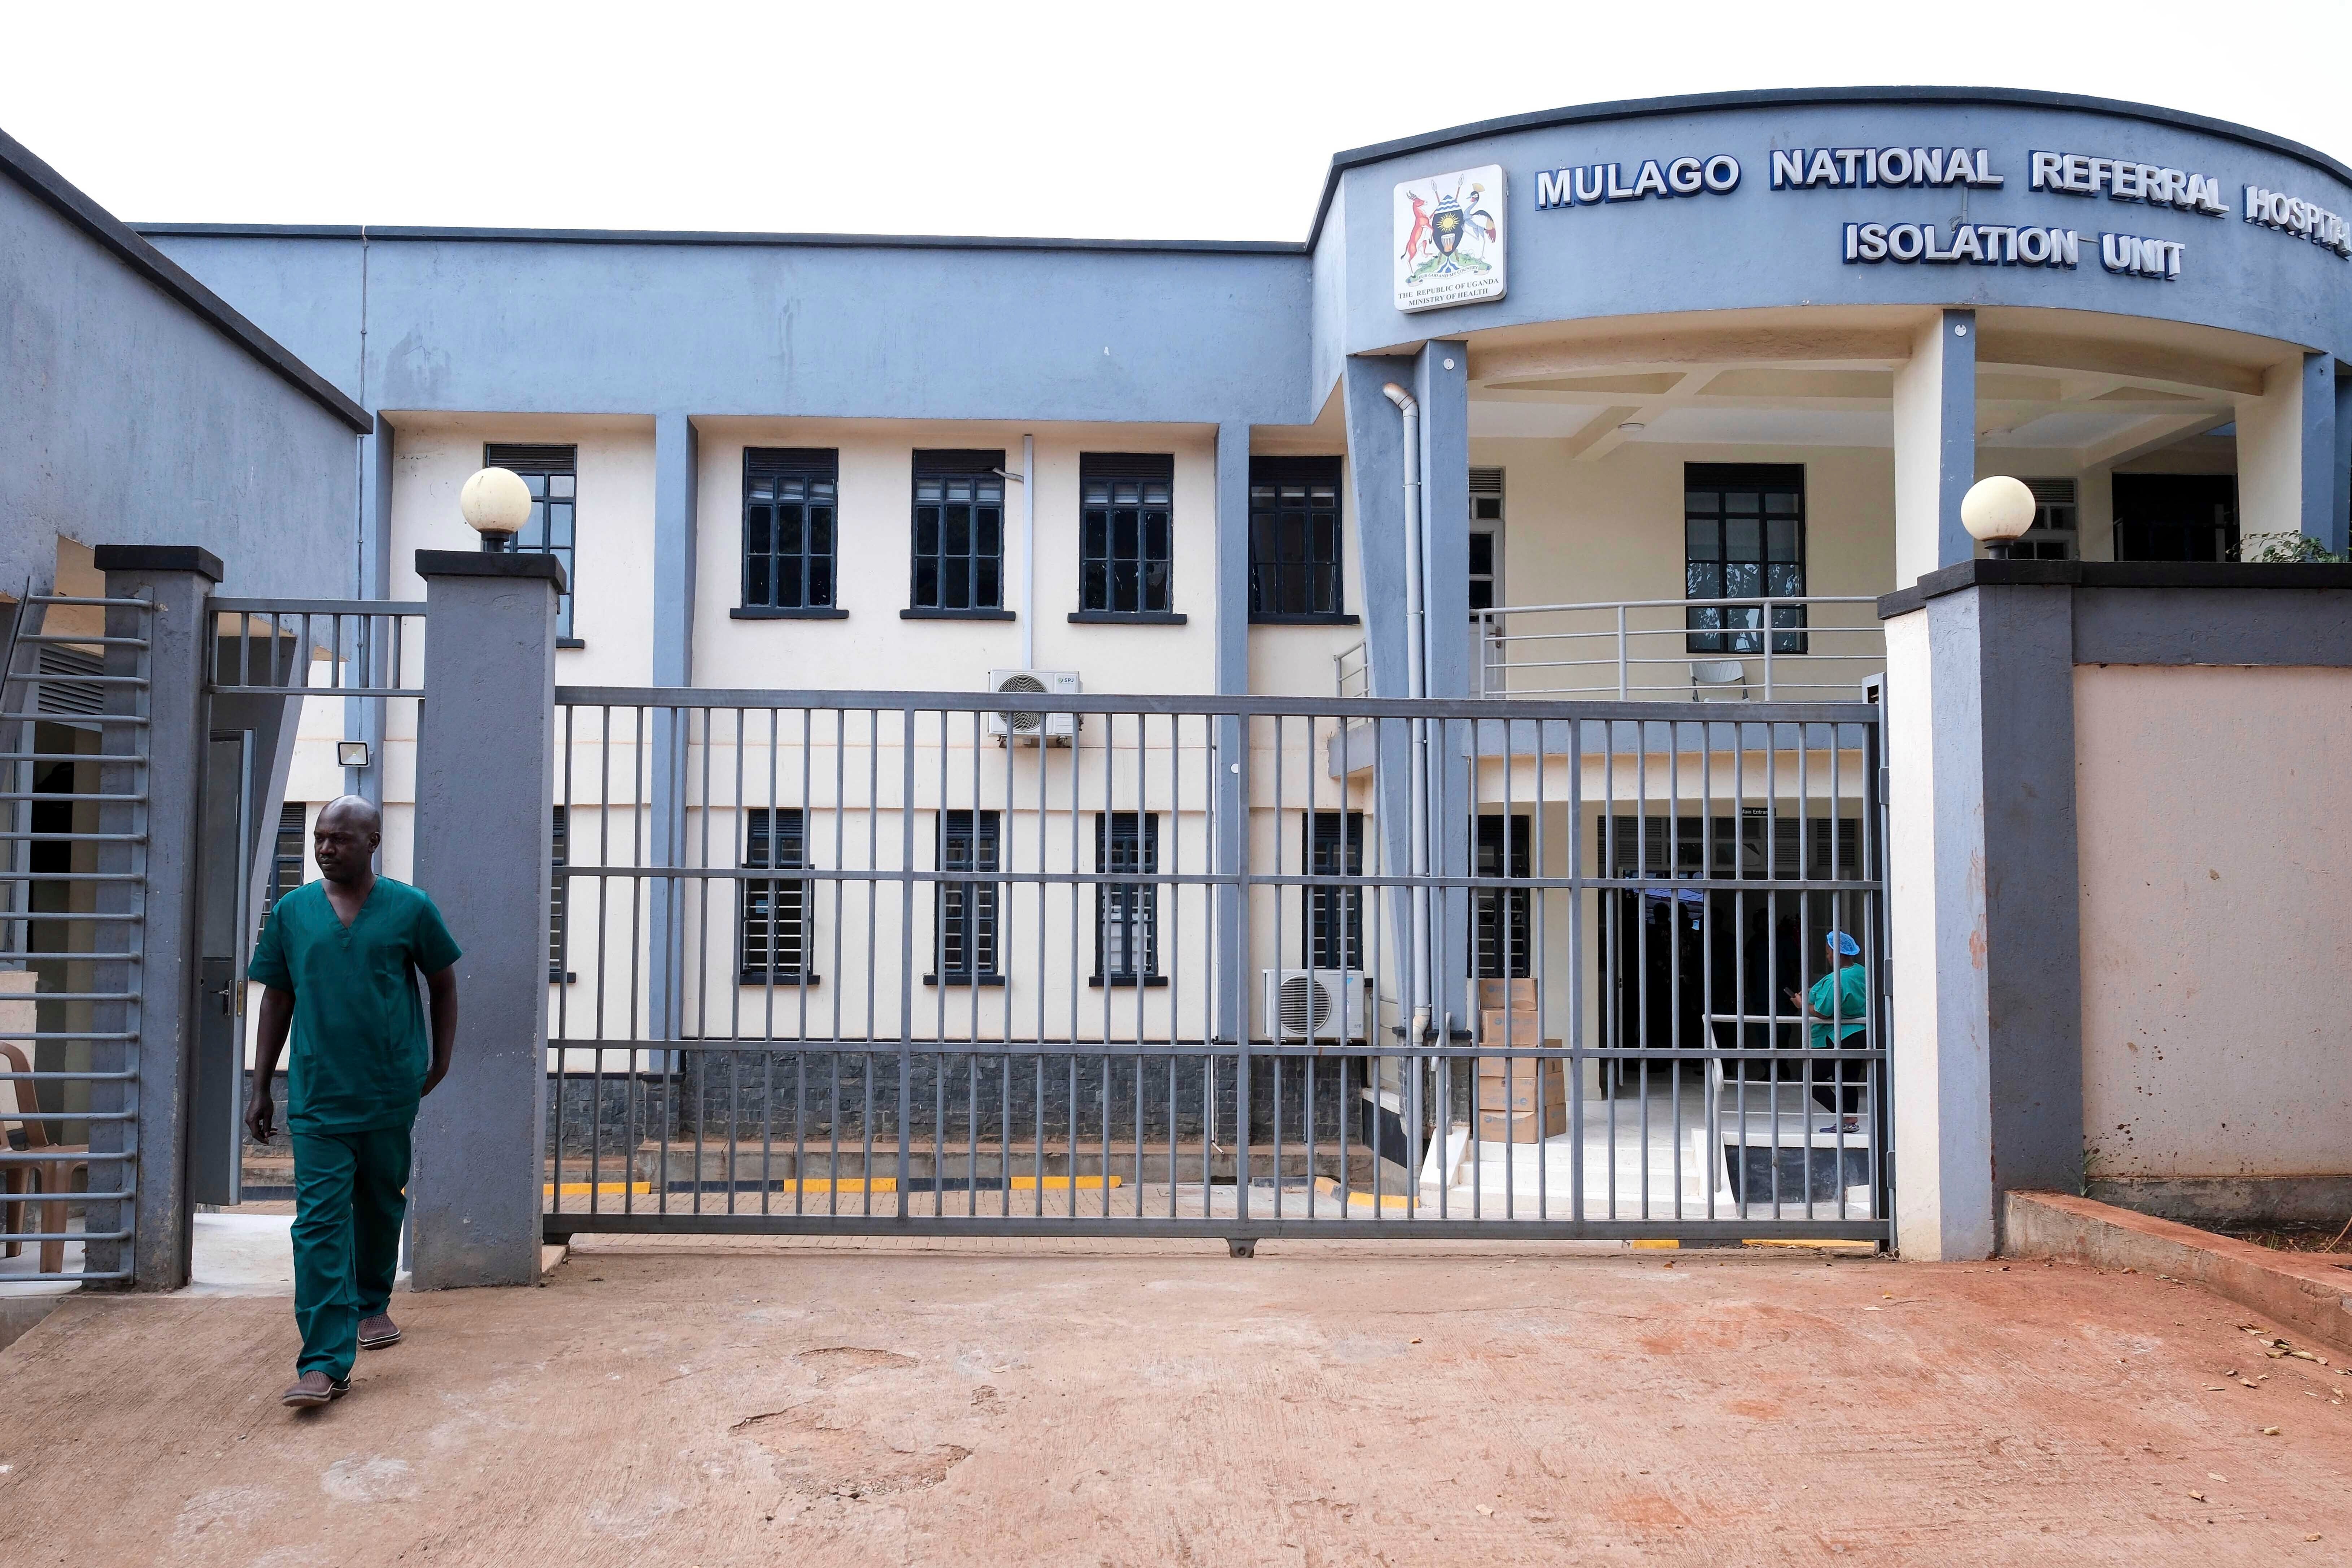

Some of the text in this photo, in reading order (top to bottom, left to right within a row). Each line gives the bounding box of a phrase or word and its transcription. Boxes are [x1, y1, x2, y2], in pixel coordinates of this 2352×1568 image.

[1536, 154, 1741, 210] MULAGO
[1770, 147, 2004, 191] NATIONAL
[2029, 149, 2230, 219] REFERRAL
[1843, 222, 2186, 281] ISOLATION UNIT
[1457, 266, 1478, 274] COUNTRY
[1417, 285, 1454, 296] REPUBLIC
[1467, 278, 1499, 288] UGANDA
[1408, 295, 1444, 306] MINISTRY
[1458, 288, 1488, 298] HEALTH
